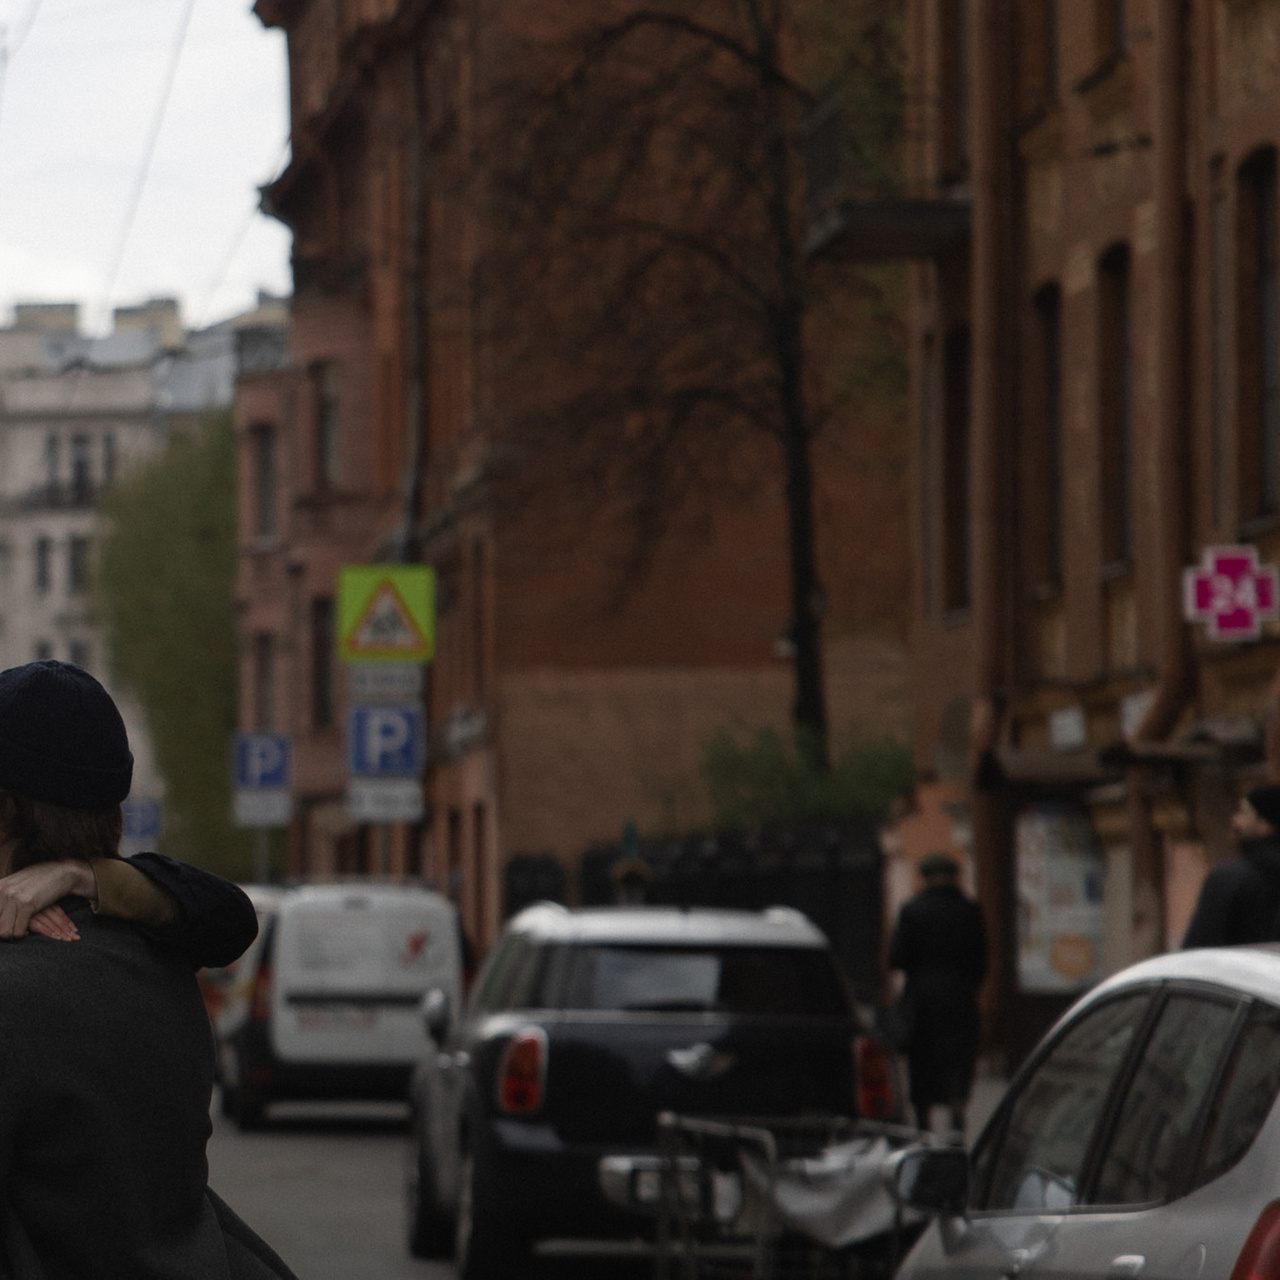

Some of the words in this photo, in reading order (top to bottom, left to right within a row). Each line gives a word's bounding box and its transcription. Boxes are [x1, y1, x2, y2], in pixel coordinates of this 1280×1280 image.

[1208, 572, 1258, 613] 24
[246, 734, 281, 788] P
[366, 707, 409, 767] P
